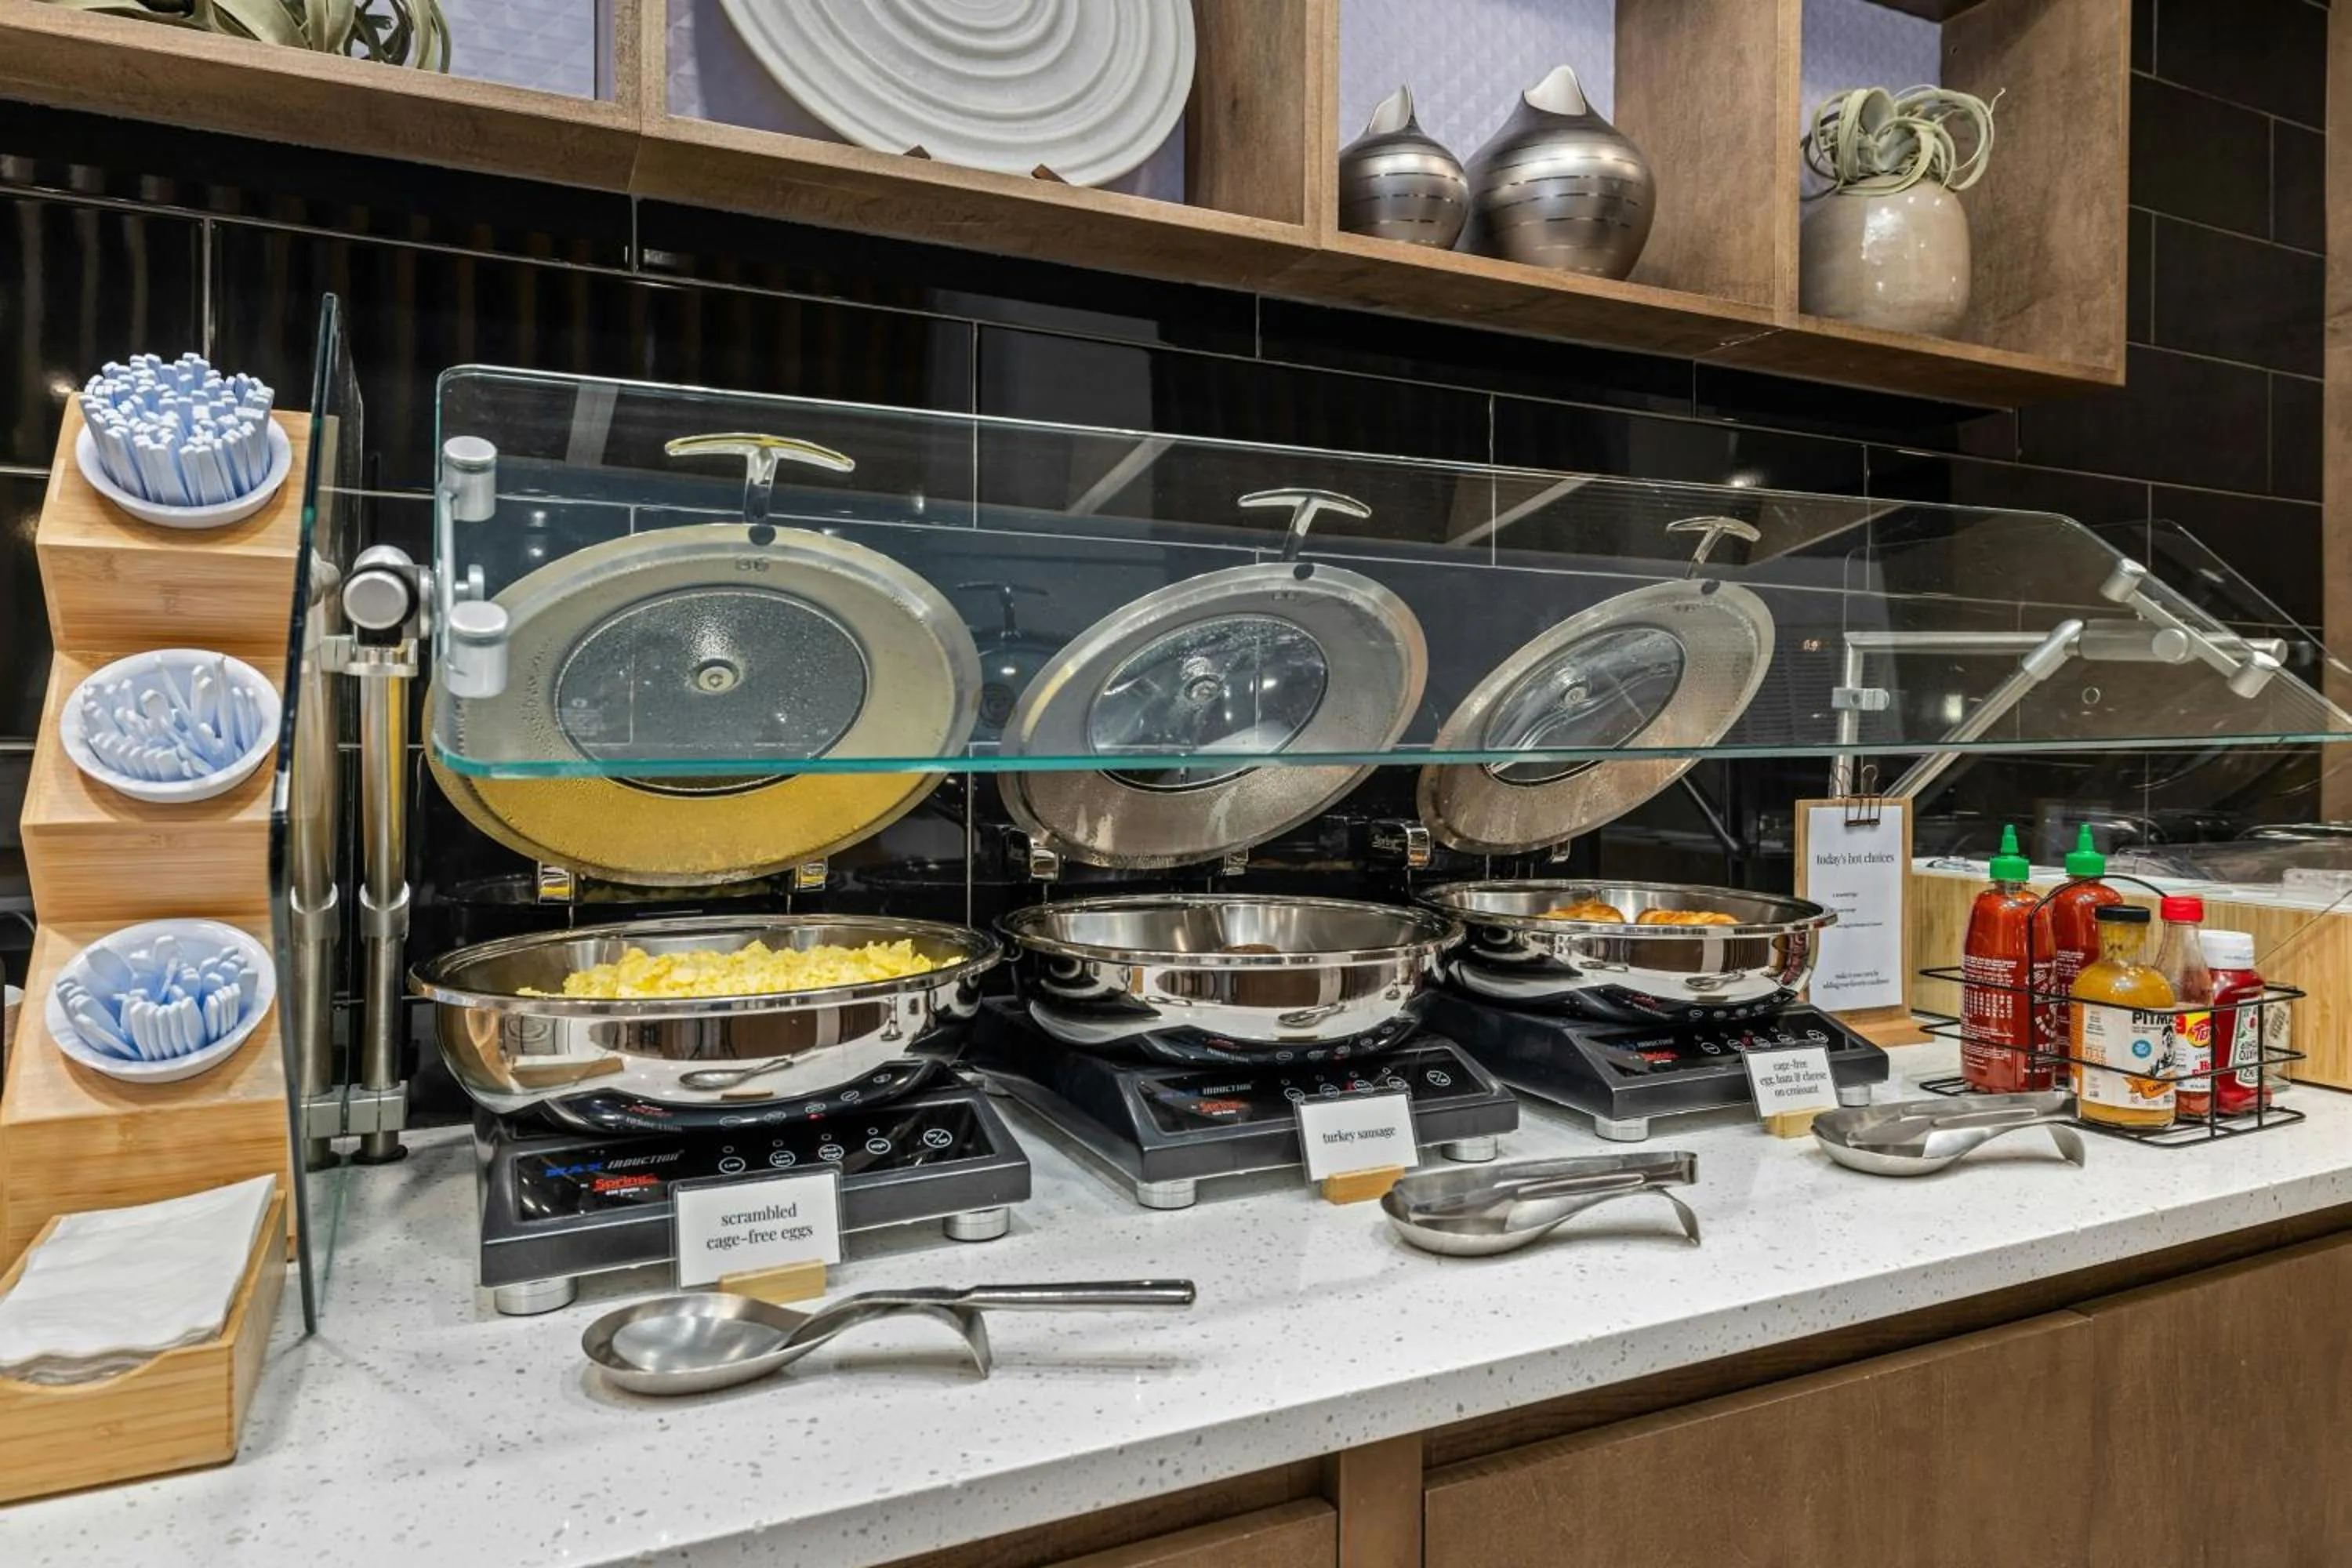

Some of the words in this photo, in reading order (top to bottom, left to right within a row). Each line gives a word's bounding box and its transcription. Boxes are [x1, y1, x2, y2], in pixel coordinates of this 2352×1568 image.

[1816, 852, 1846, 866] today's
[1848, 852, 1862, 865] hot
[1864, 851, 1895, 864] choices
[1773, 1058, 1807, 1073] cage-free
[1802, 1070, 1828, 1081] cheese
[1774, 1088, 1786, 1097] on
[1323, 1130, 1355, 1145] turkey
[1357, 1127, 1396, 1140] sausage
[720, 1202, 798, 1228] scrambled
[706, 1228, 778, 1251] cage-free
[781, 1225, 815, 1241] eggs
